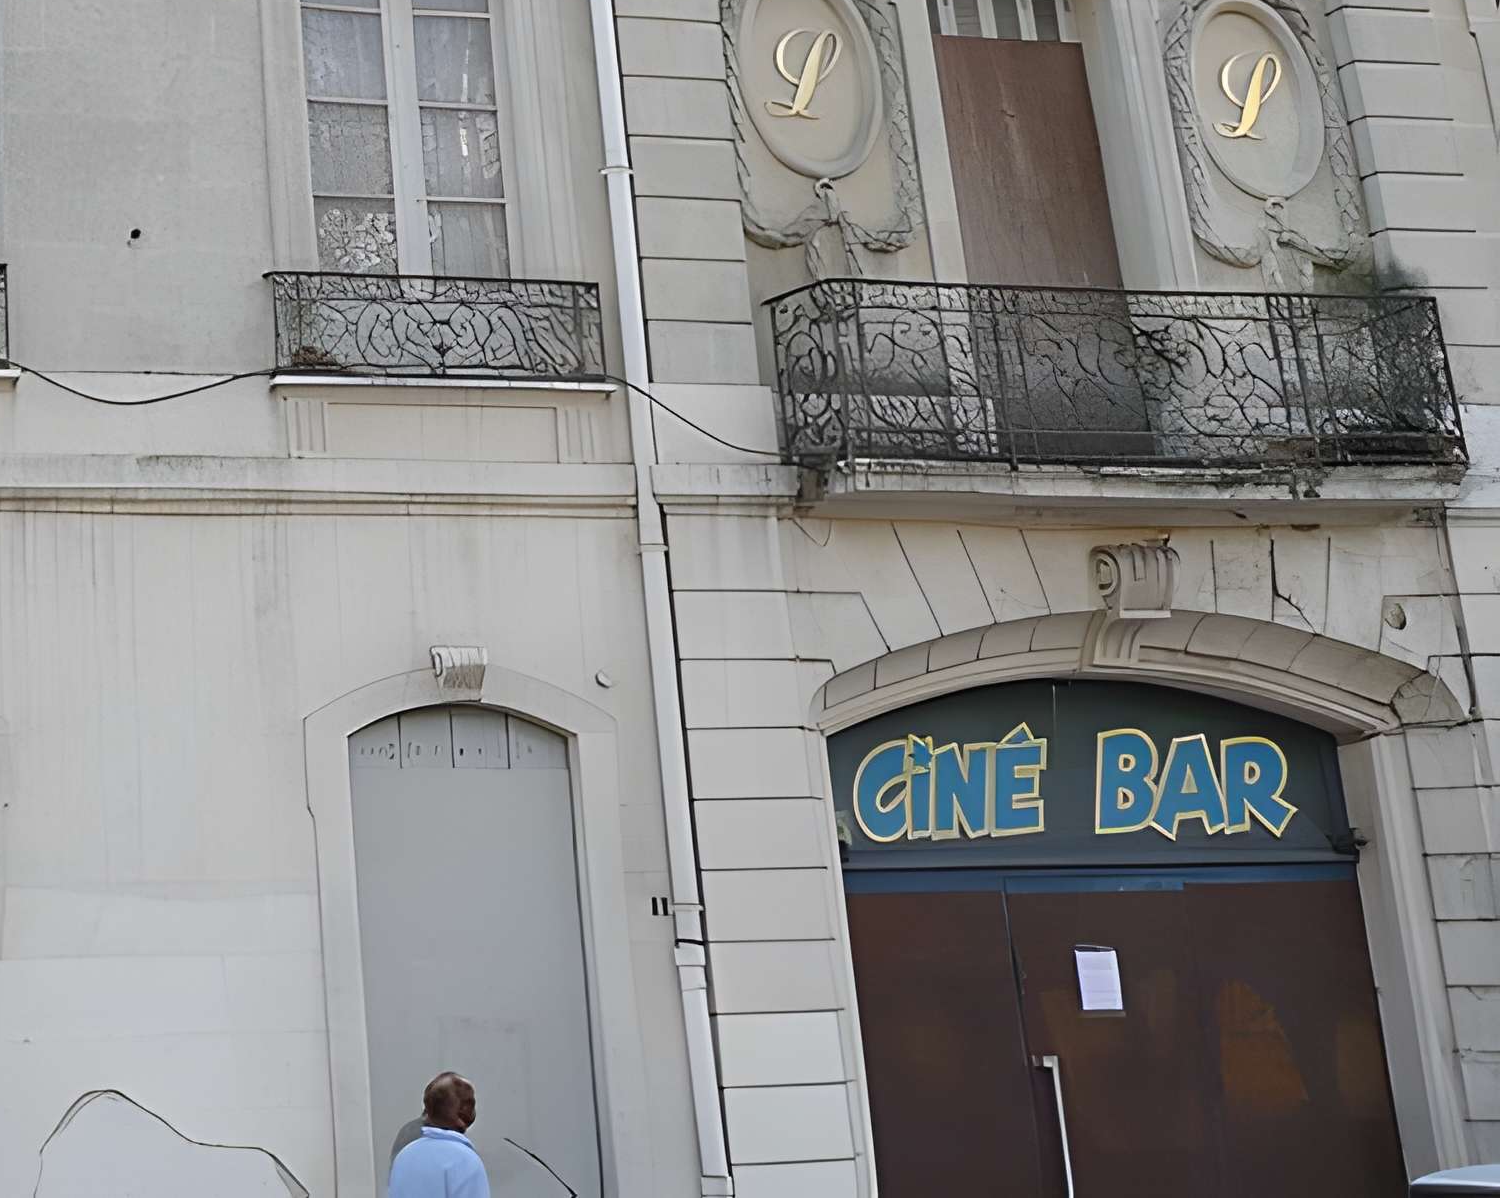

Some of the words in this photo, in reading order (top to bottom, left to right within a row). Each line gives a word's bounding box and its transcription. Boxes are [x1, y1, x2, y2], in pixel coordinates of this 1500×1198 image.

[765, 28, 842, 120] L
[1213, 52, 1283, 140] L
[1095, 728, 1299, 841] BAR
